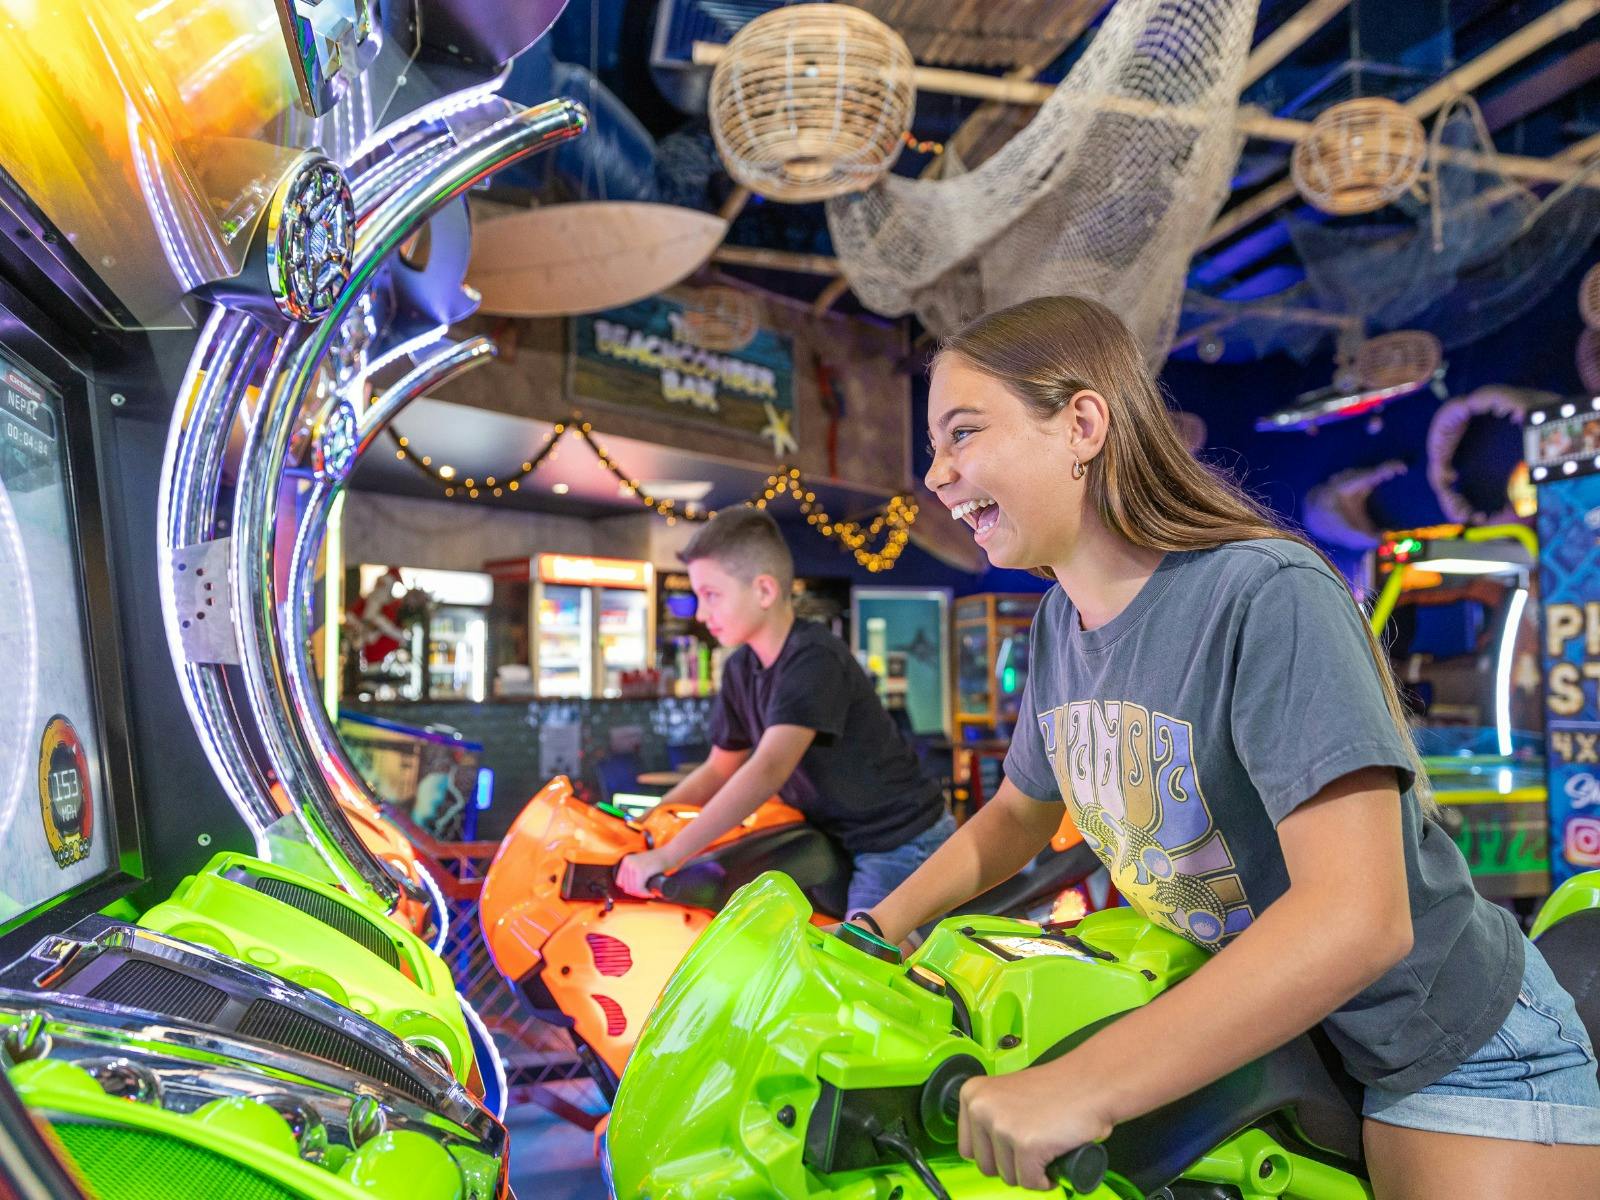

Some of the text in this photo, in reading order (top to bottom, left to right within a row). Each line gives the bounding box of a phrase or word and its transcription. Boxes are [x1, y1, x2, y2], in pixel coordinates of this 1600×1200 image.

[8, 390, 38, 421] NEPAL
[53, 768, 79, 801] 153
[61, 804, 78, 822] MPH
